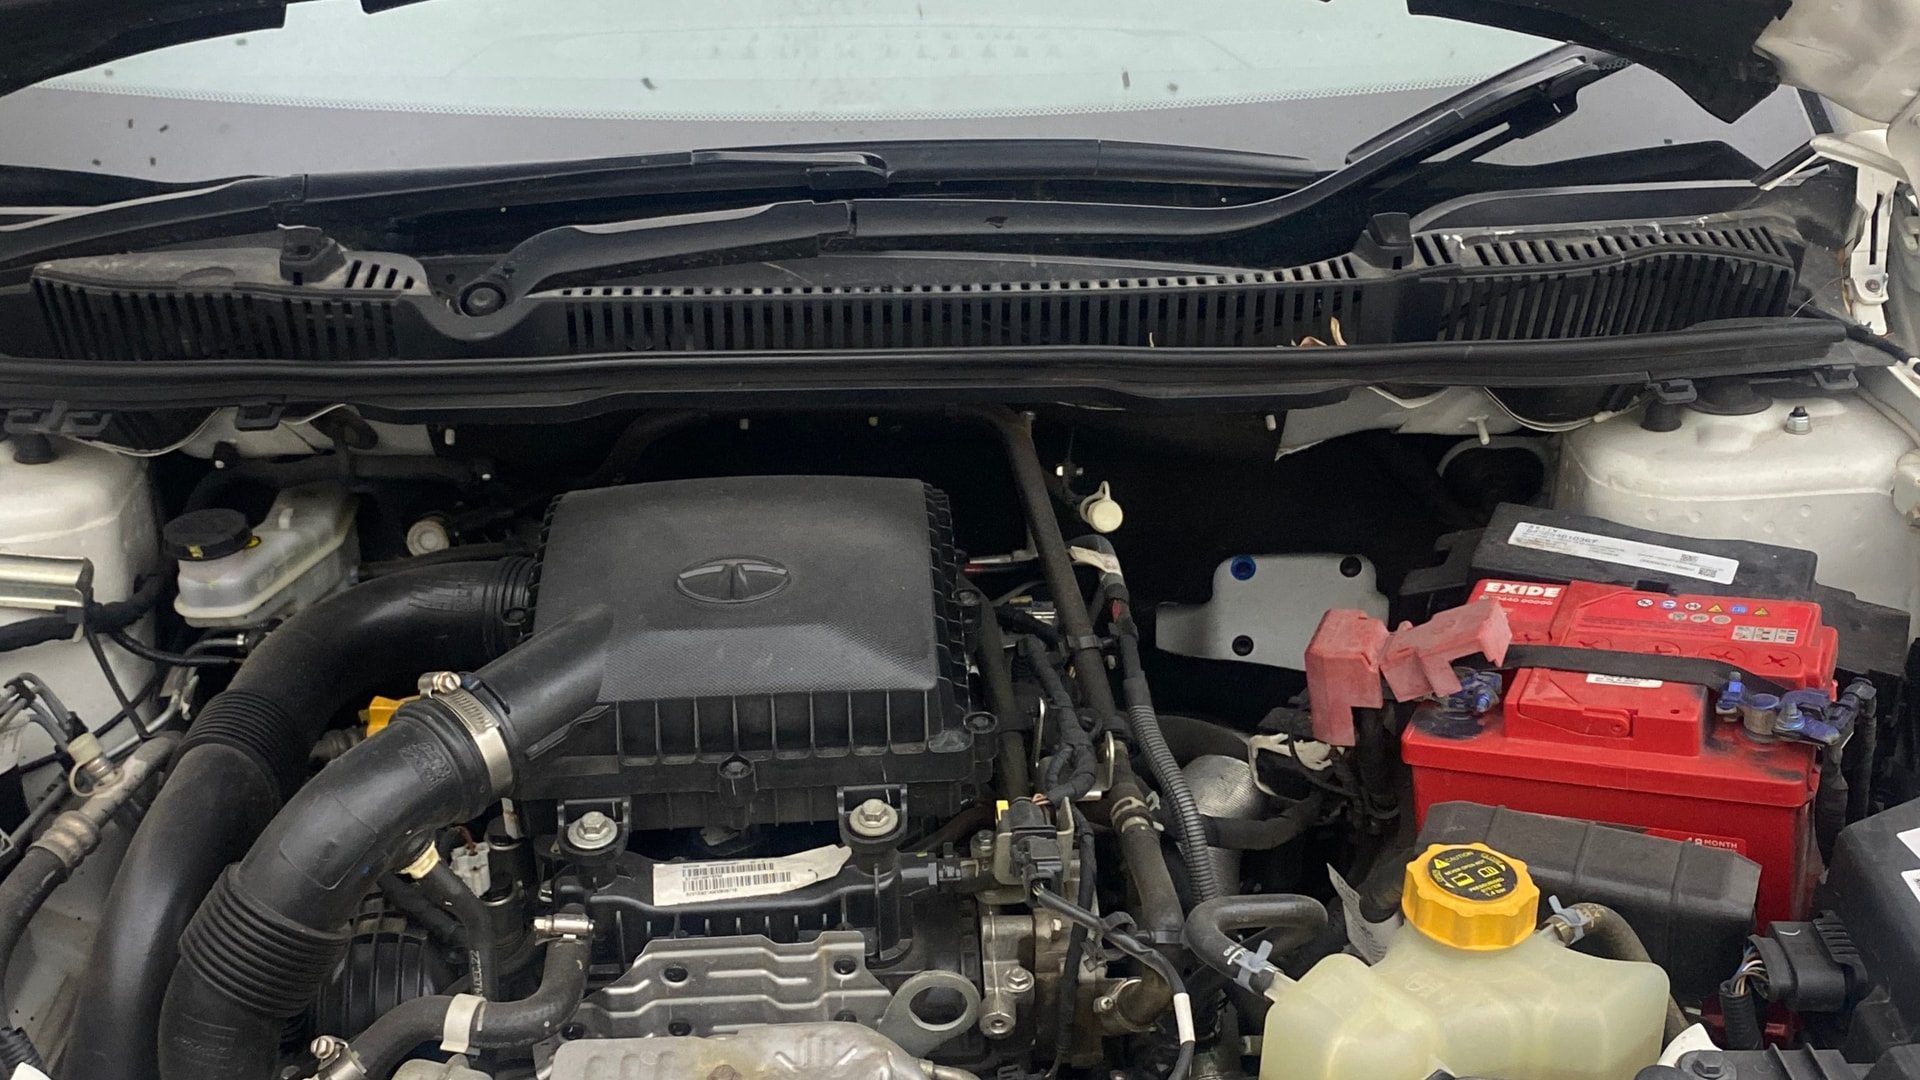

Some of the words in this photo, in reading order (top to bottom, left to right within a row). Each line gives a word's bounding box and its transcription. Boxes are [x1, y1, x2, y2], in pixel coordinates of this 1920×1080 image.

[1485, 582, 1561, 598] EXIDE
[1704, 839, 1738, 849] MONTH
[1444, 851, 1474, 863] CAUTION
